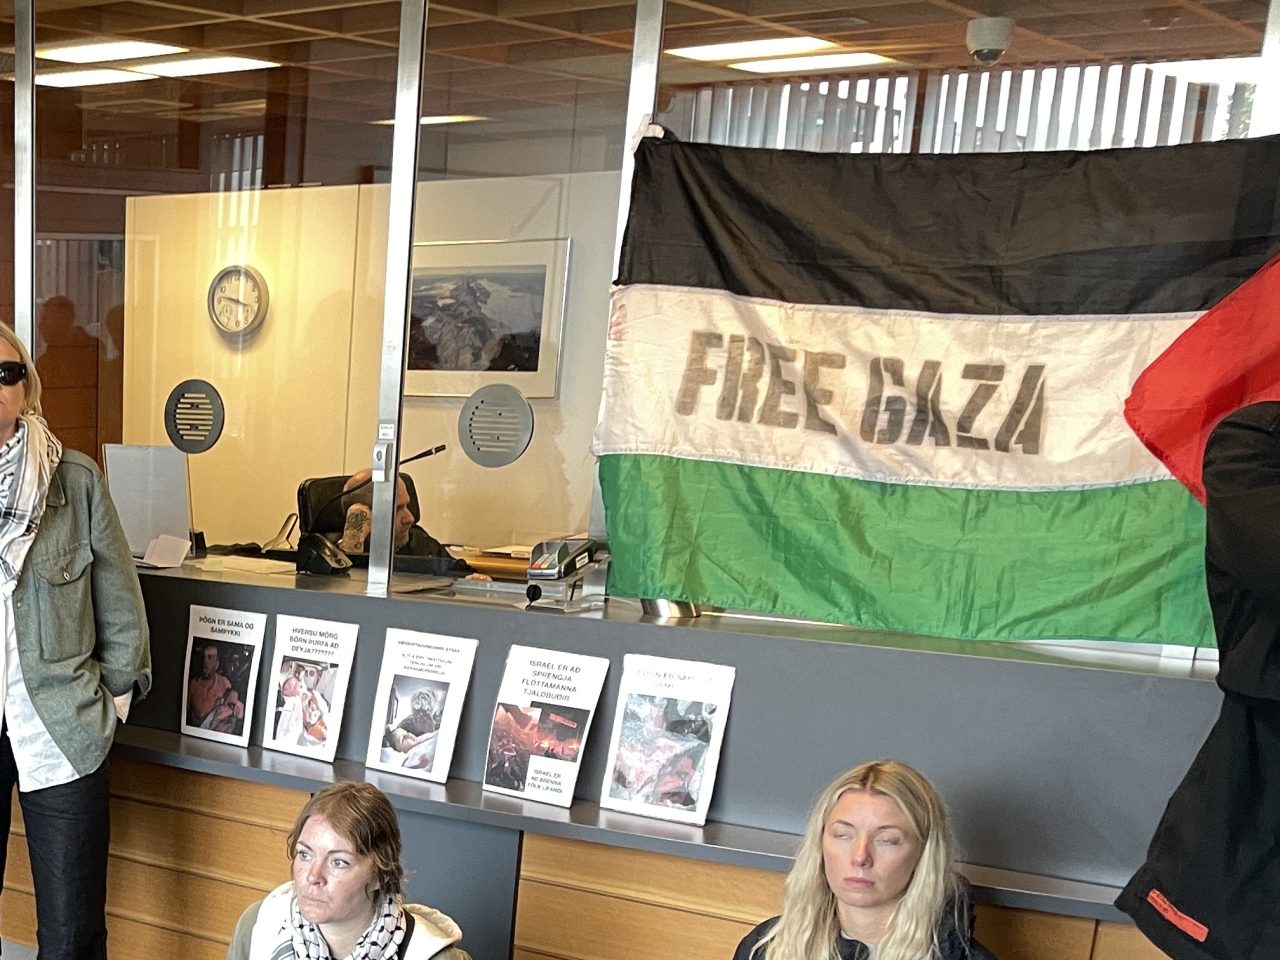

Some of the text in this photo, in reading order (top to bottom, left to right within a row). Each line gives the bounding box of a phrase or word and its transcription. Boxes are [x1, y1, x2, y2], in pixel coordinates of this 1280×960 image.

[674, 330, 1046, 455] FREE GAZA
[529, 659, 555, 670] ISRAEL
